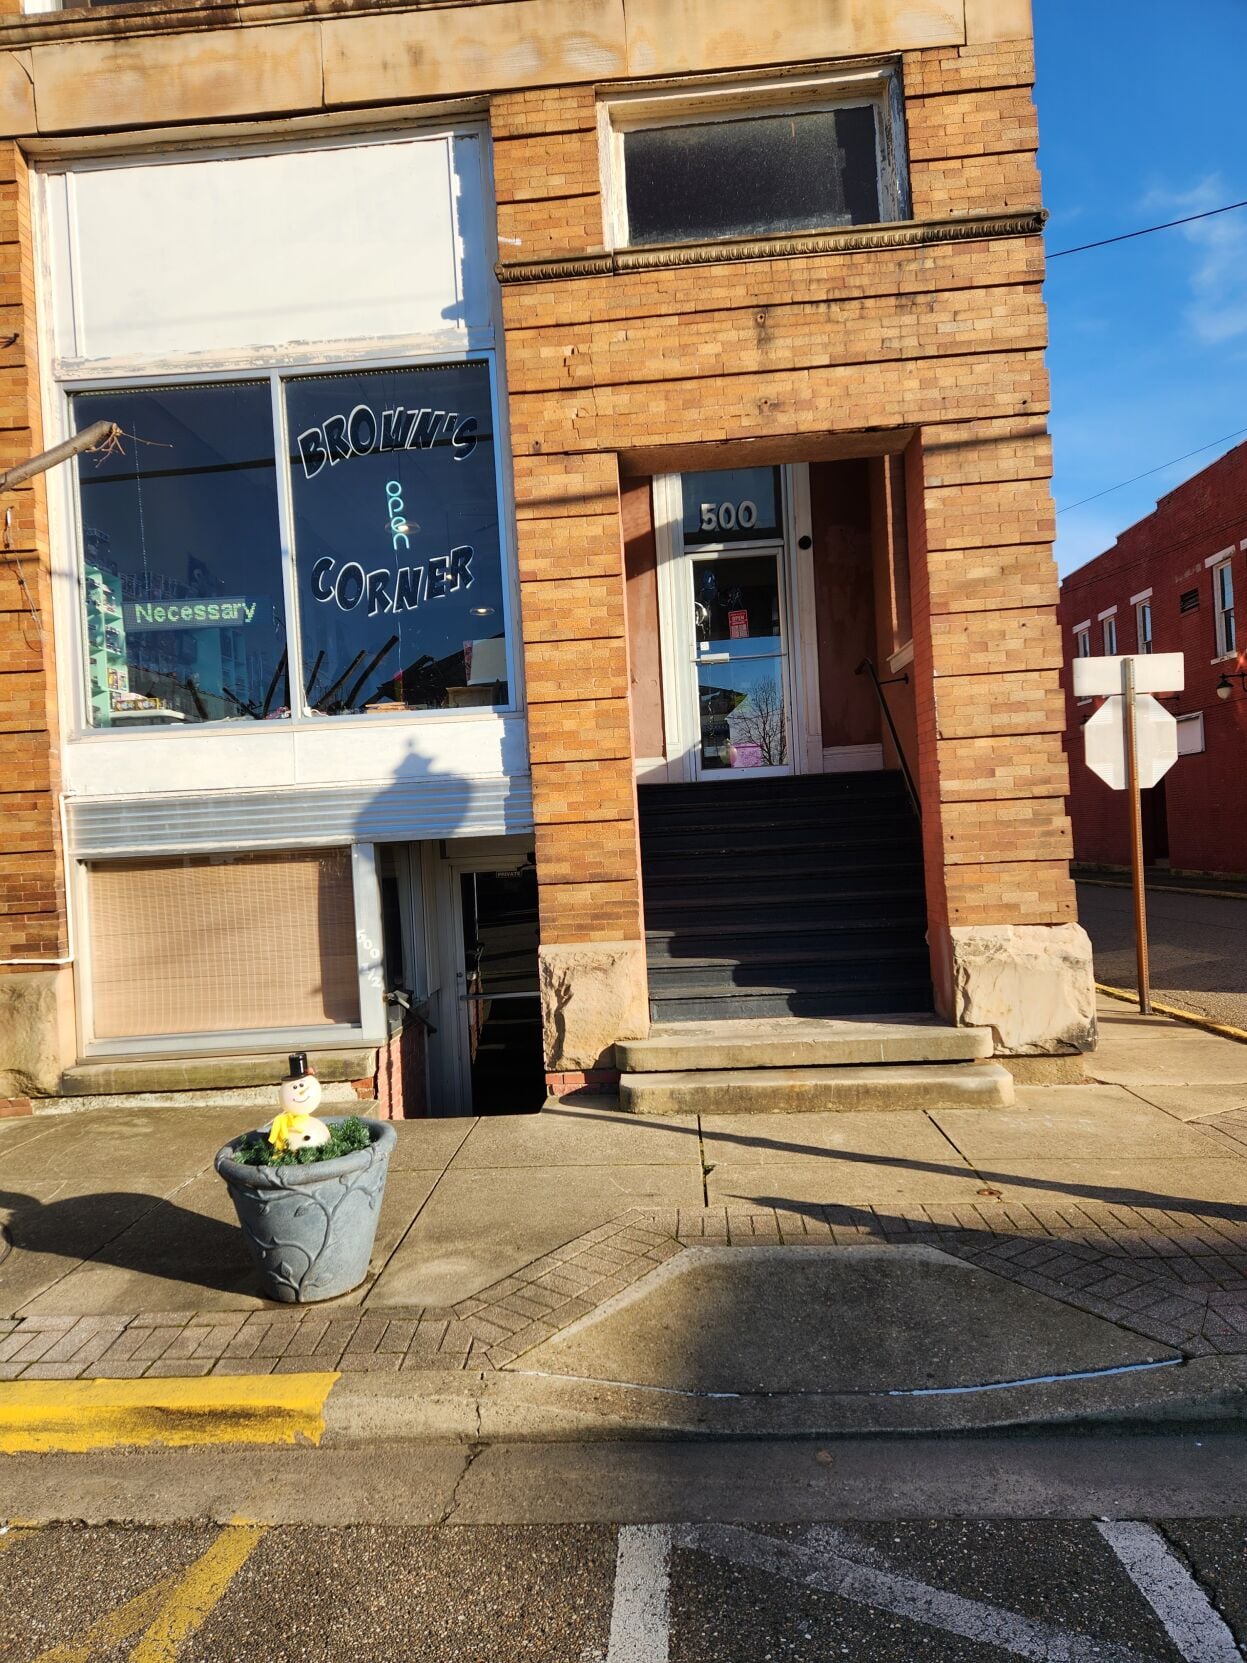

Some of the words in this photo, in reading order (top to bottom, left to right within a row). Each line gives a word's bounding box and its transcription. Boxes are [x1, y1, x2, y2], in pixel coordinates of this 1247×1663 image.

[297, 404, 478, 479] BROWN'S
[701, 500, 757, 530] 500
[311, 545, 475, 617] CORNER
[134, 602, 257, 623] Necessary
